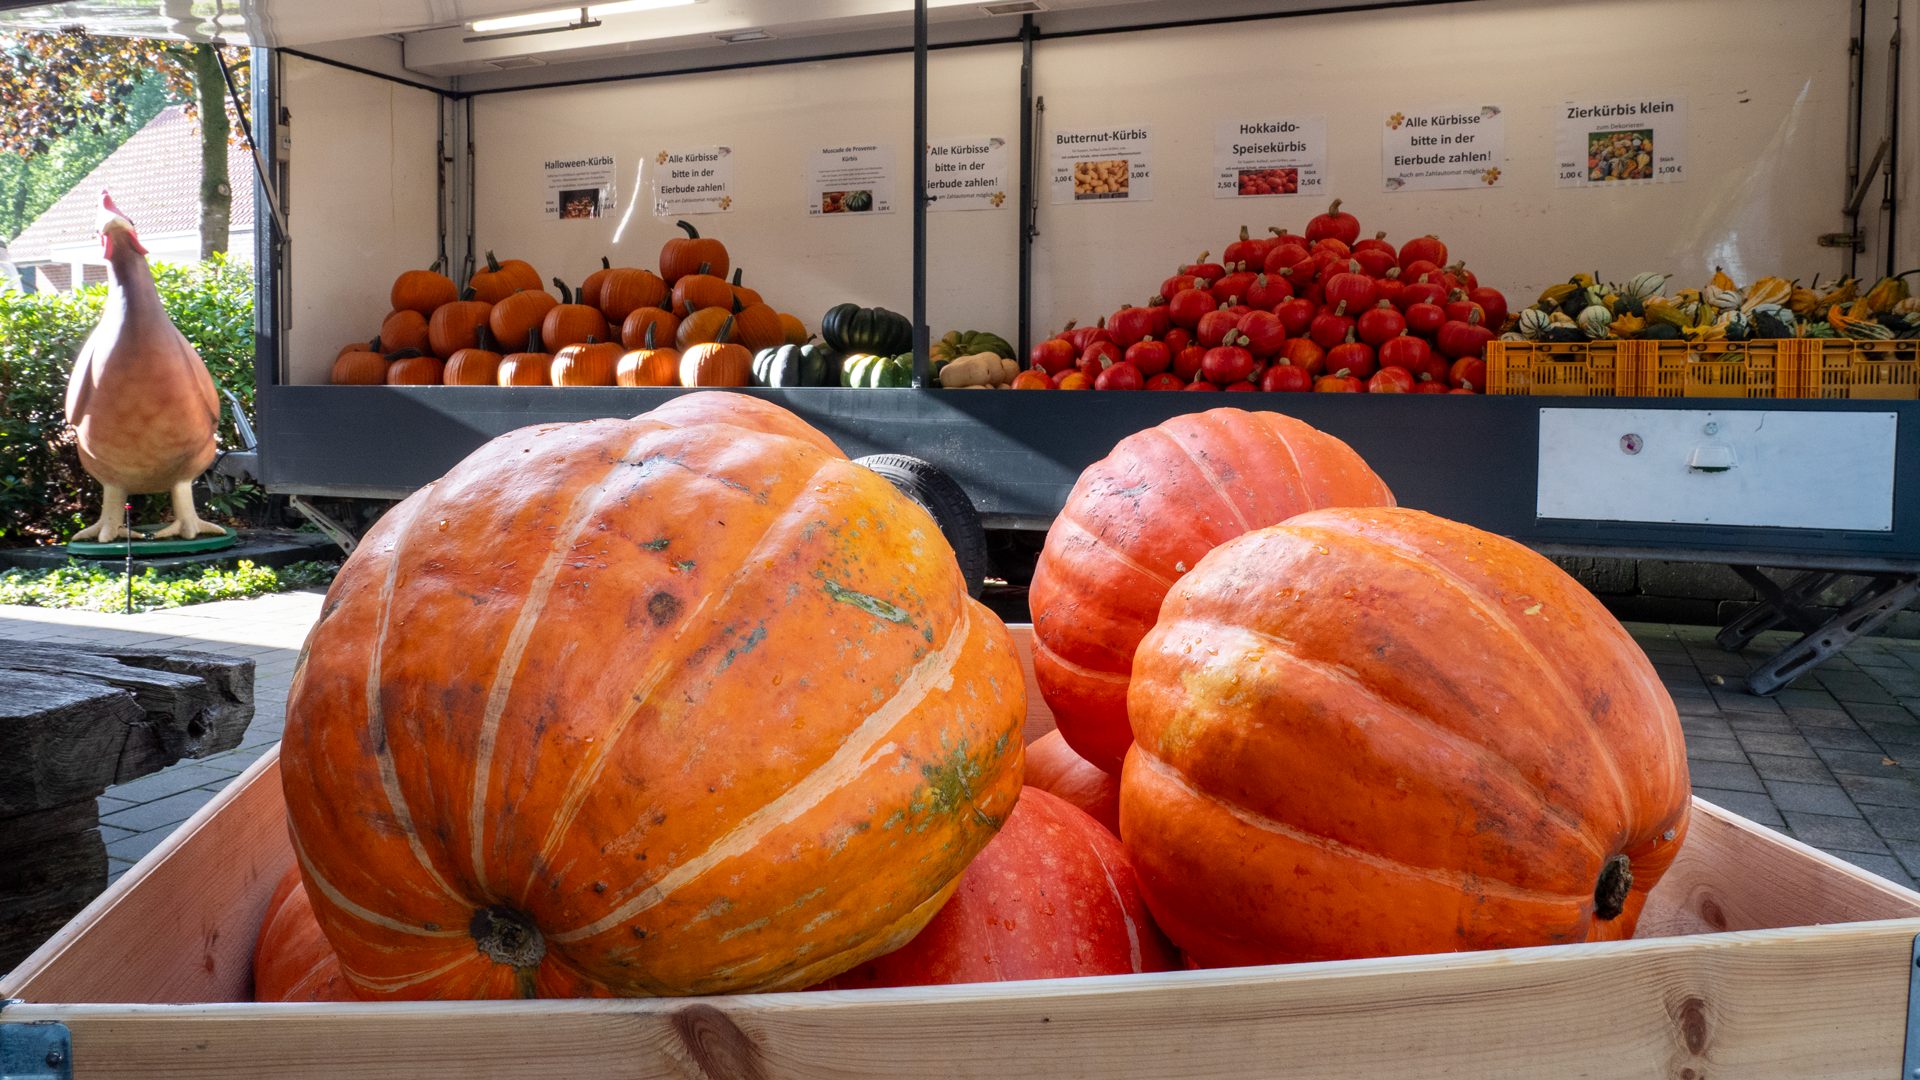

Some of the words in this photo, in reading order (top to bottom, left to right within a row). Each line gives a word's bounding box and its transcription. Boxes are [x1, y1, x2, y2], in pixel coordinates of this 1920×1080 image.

[1568, 104, 1636, 119] Zierkürbis
[1641, 102, 1674, 114] klein
[1406, 117, 1428, 128] Alle
[1431, 114, 1480, 126] Kürbisse
[1240, 122, 1300, 134] Hokkaido-
[1057, 129, 1147, 144] Butternut-Kürbis
[1411, 136, 1437, 146] bitte
[1441, 135, 1451, 144] in
[1455, 133, 1475, 143] der
[931, 147, 948, 156] Alle
[951, 145, 989, 154] Kürbisse
[1233, 141, 1306, 156] Speisekürbis
[545, 156, 613, 169] Halloween-Kürbis
[668, 155, 683, 163] Alle
[685, 153, 718, 162] Kürbisse
[1395, 154, 1445, 166] Eierbude
[1448, 151, 1491, 163] zahlen!
[672, 170, 690, 178] bitte
[701, 168, 714, 176] der
[935, 163, 956, 172] bitte
[959, 162, 967, 171] in
[970, 162, 985, 170] der
[661, 185, 695, 194] Eierbude
[697, 183, 725, 192] zahlen!
[926, 179, 962, 188] ierbude
[965, 177, 997, 187] zahlen!
